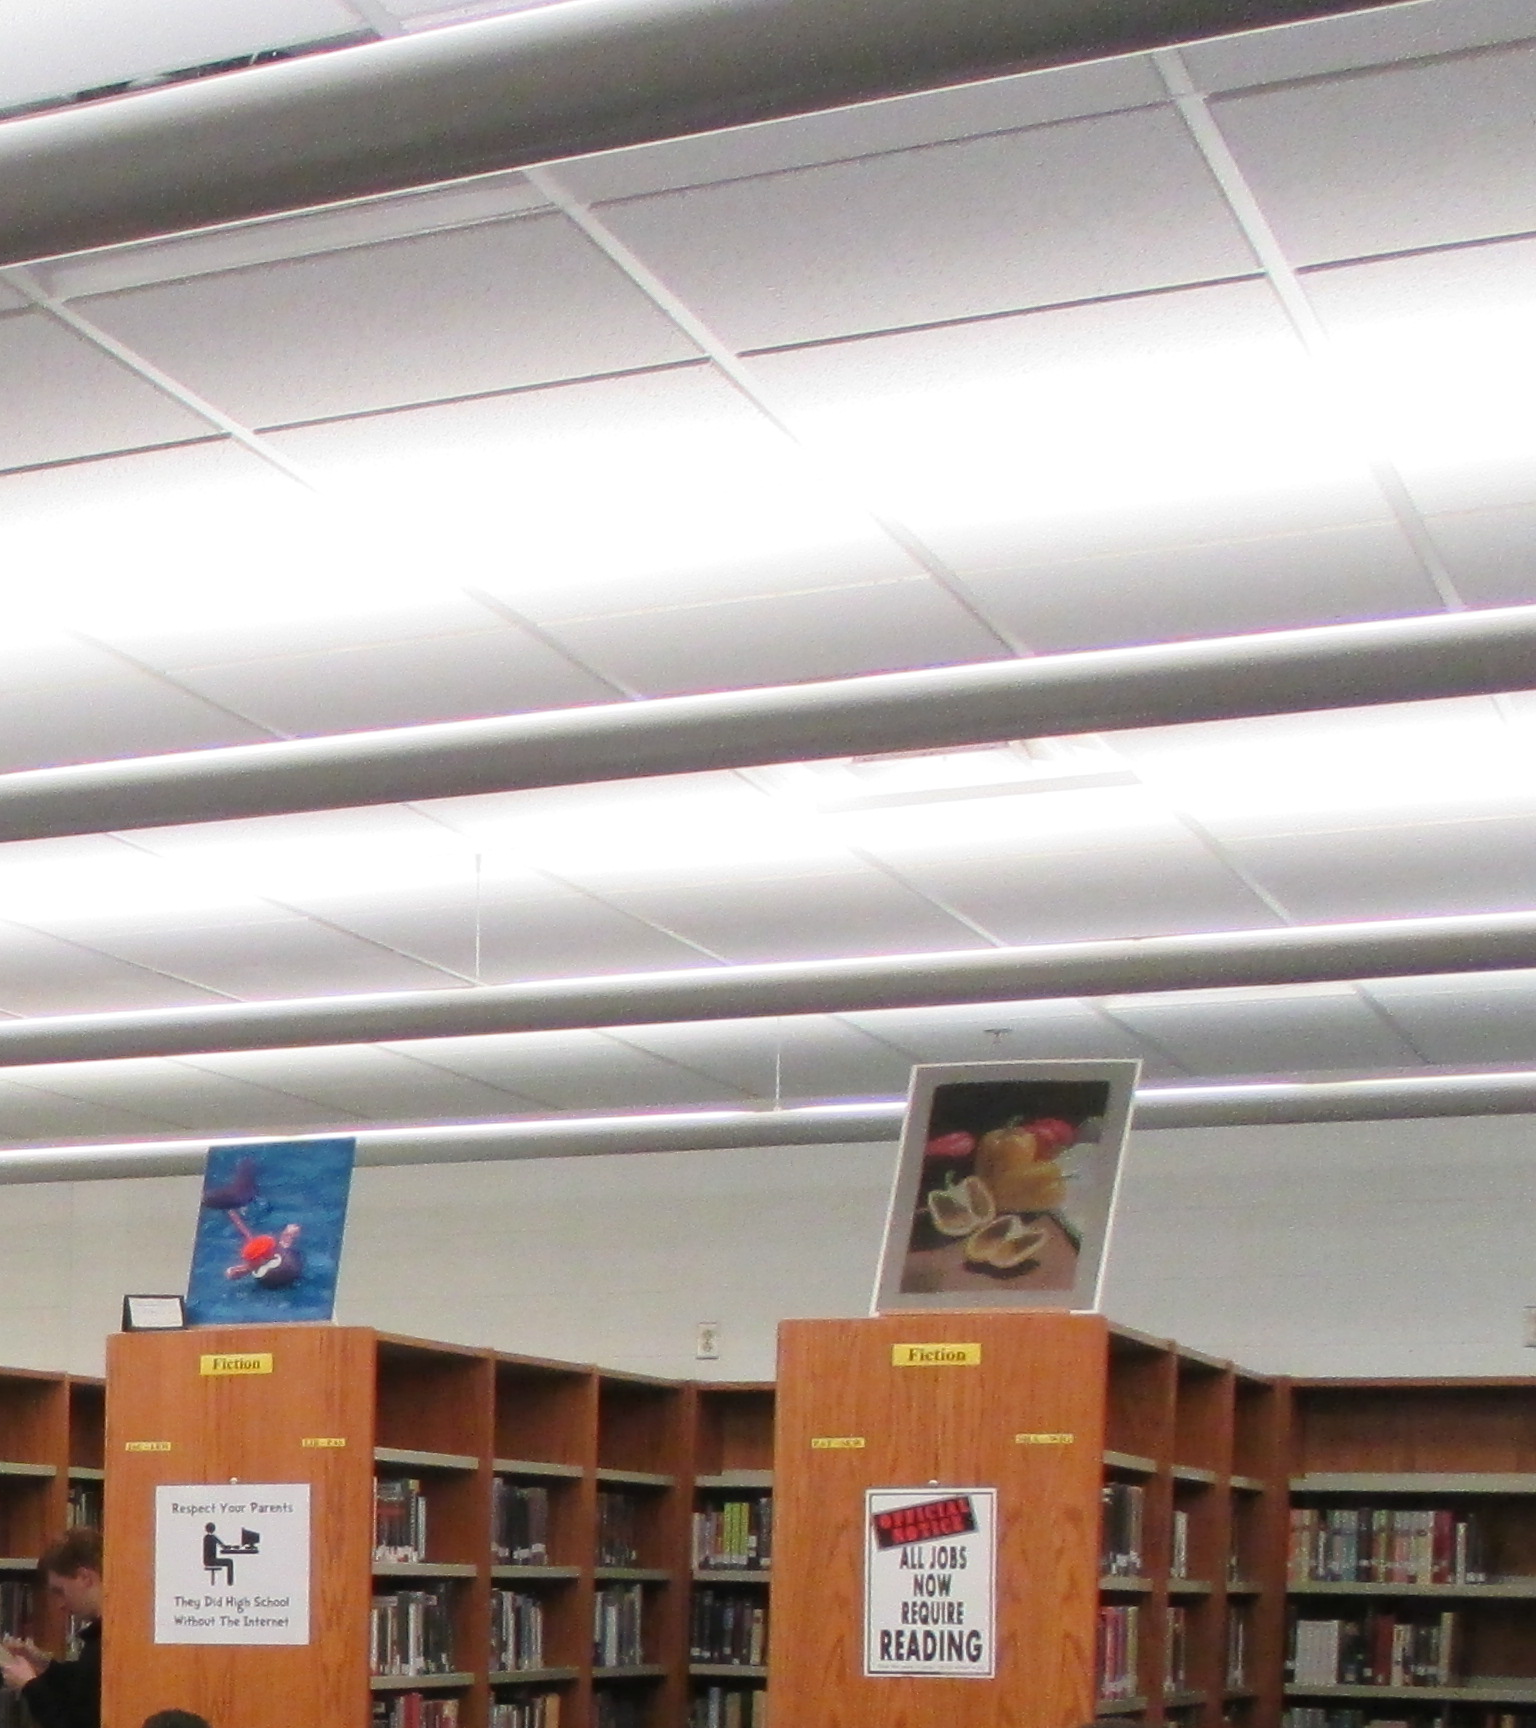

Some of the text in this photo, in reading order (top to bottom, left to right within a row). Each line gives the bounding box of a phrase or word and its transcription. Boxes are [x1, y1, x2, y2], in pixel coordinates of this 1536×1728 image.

[212, 1357, 261, 1371] Fiction
[907, 1348, 967, 1361] Fiction
[172, 1502, 293, 1517] Respect Your Parents
[879, 1497, 970, 1530] OFFICIAL
[892, 1515, 966, 1542] NOTICE
[899, 1546, 967, 1570] ALL JOBS
[913, 1574, 952, 1597] NOW
[174, 1596, 289, 1613] They Did High School
[901, 1601, 964, 1625] REQUIRE
[174, 1615, 289, 1627] Without The Internet
[879, 1629, 984, 1663] READING
